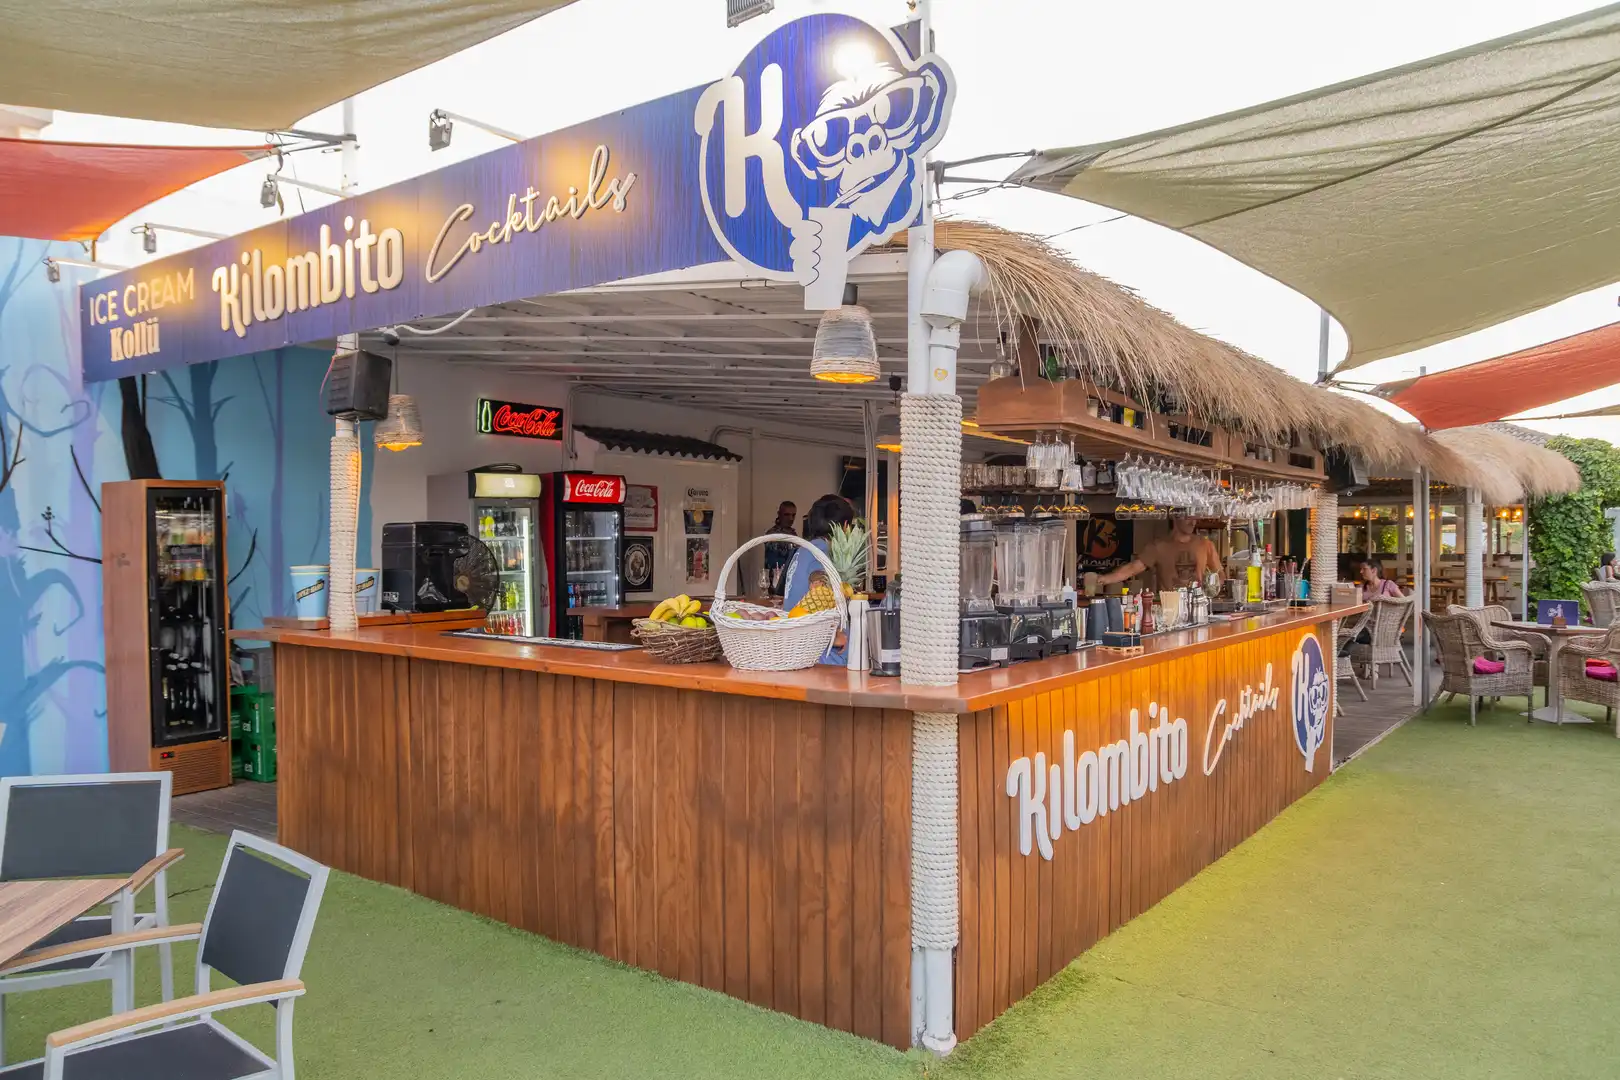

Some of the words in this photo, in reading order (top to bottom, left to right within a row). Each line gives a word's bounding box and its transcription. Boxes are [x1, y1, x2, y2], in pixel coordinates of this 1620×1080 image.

[212, 215, 405, 339] Kilombito
[425, 144, 637, 284] Cocktails
[89, 290, 119, 327] ICE
[123, 267, 195, 318] CREAM
[110, 316, 161, 362] Kollü
[493, 405, 560, 437] Coca-Cola
[575, 479, 616, 498] Coca-Cola
[1006, 701, 1188, 861] Kilombito
[1203, 662, 1280, 777] Cocktails
